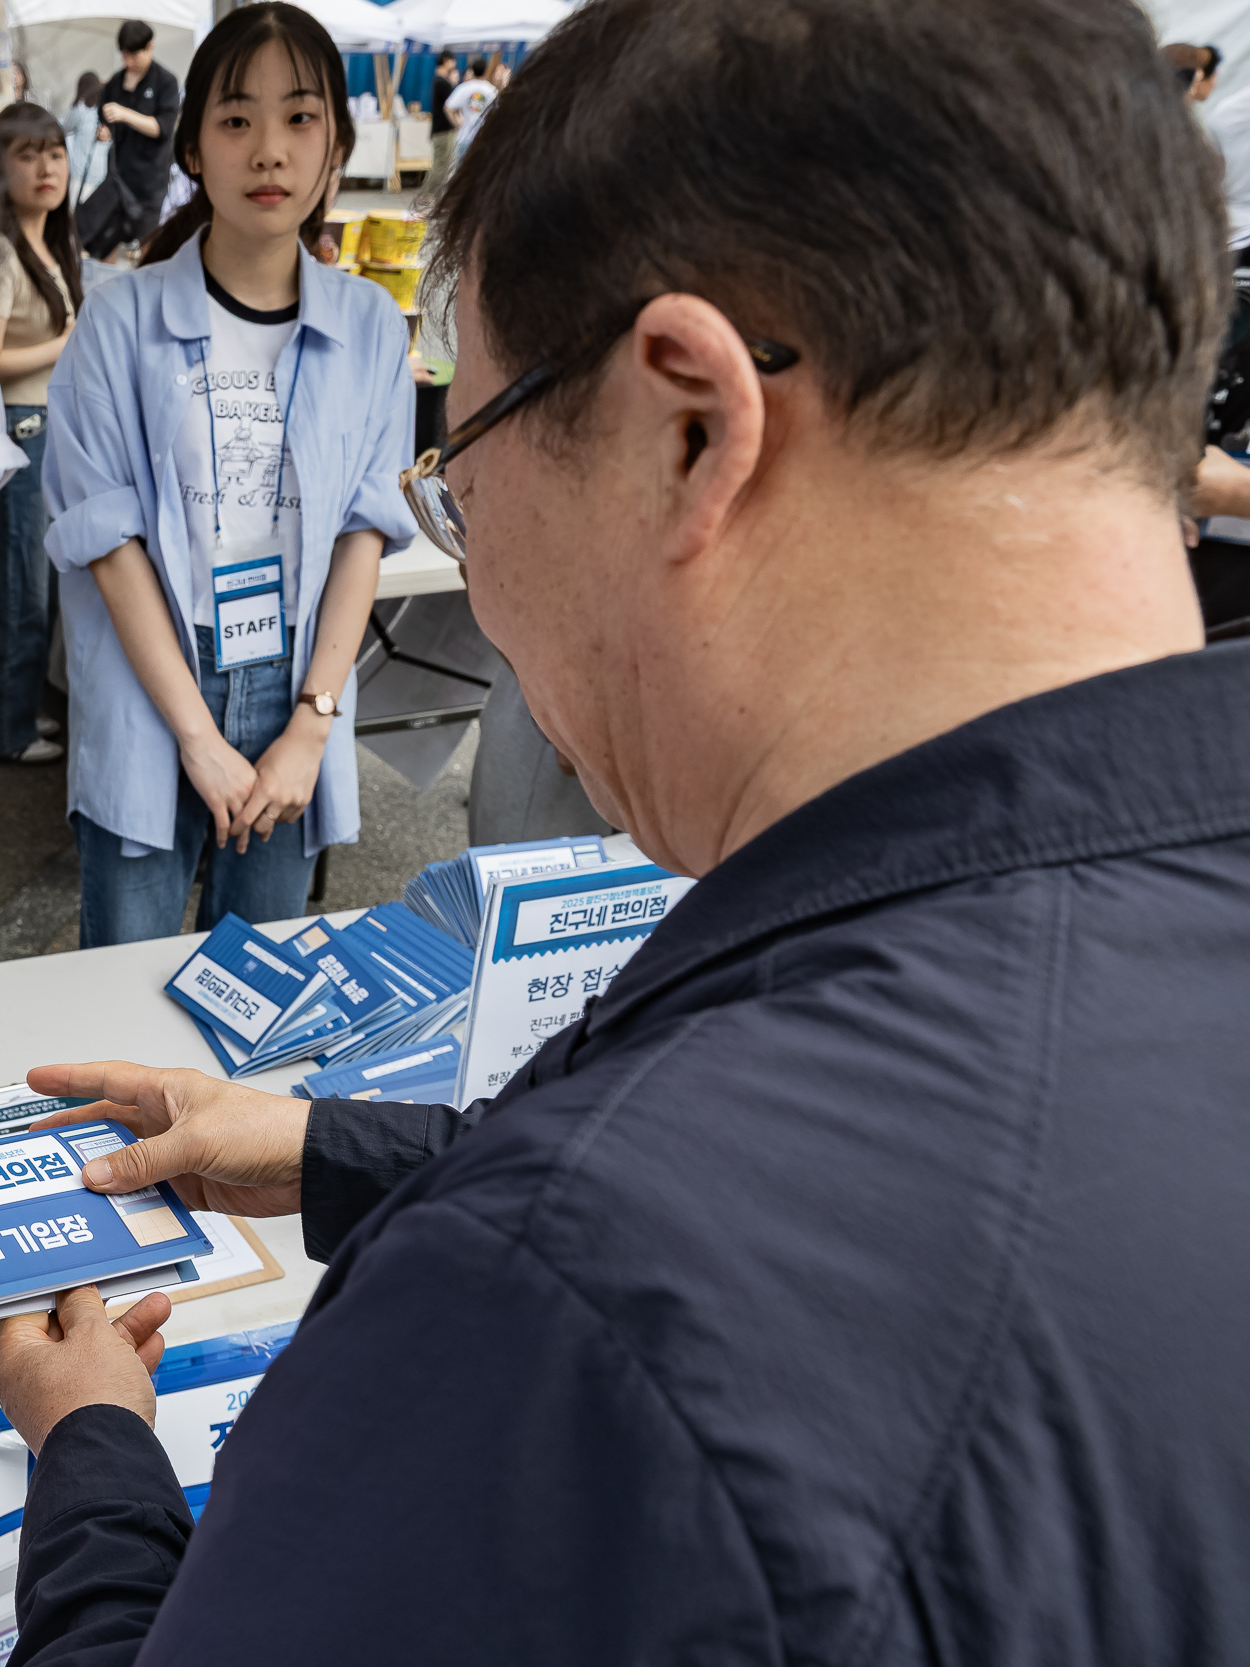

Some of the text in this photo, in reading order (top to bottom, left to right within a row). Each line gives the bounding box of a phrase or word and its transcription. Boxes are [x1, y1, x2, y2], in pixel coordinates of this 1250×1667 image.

[224, 616, 278, 639] STAFF
[549, 895, 668, 934] 진구네 편의점
[561, 898, 584, 909] 2025
[194, 967, 230, 998] 편의점
[527, 972, 574, 1003] 현장
[223, 986, 260, 1021] 진구네
[530, 1011, 585, 1032] 진구네 편
[0, 1213, 95, 1254] 기입장
